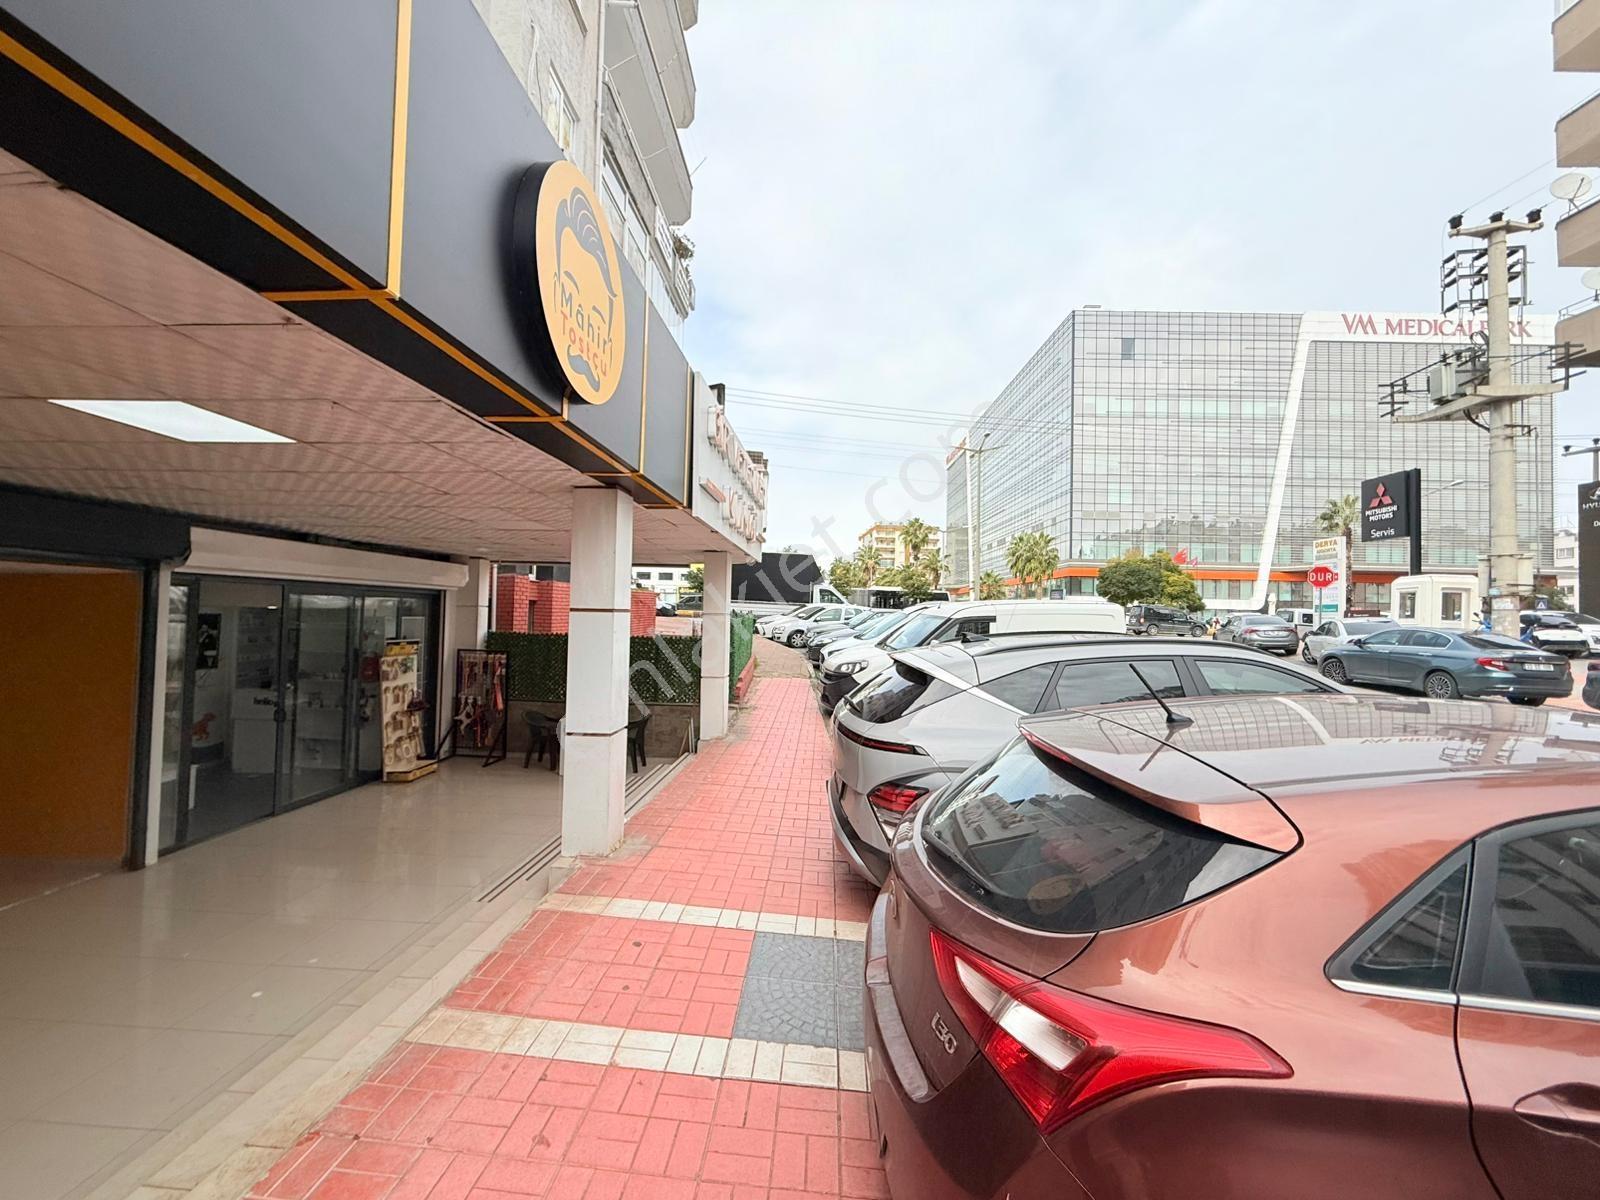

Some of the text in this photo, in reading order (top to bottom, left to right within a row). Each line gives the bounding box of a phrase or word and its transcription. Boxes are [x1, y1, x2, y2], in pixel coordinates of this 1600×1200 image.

[561, 283, 607, 355] Mâhir
[1385, 317, 1533, 339] MEDICALPRK
[561, 309, 607, 377] Tostçu
[1365, 504, 1398, 517] MITSUBISHI
[1369, 511, 1394, 523] MOTORS
[1371, 527, 1396, 539] Servis
[1309, 571, 1333, 582] DUR
